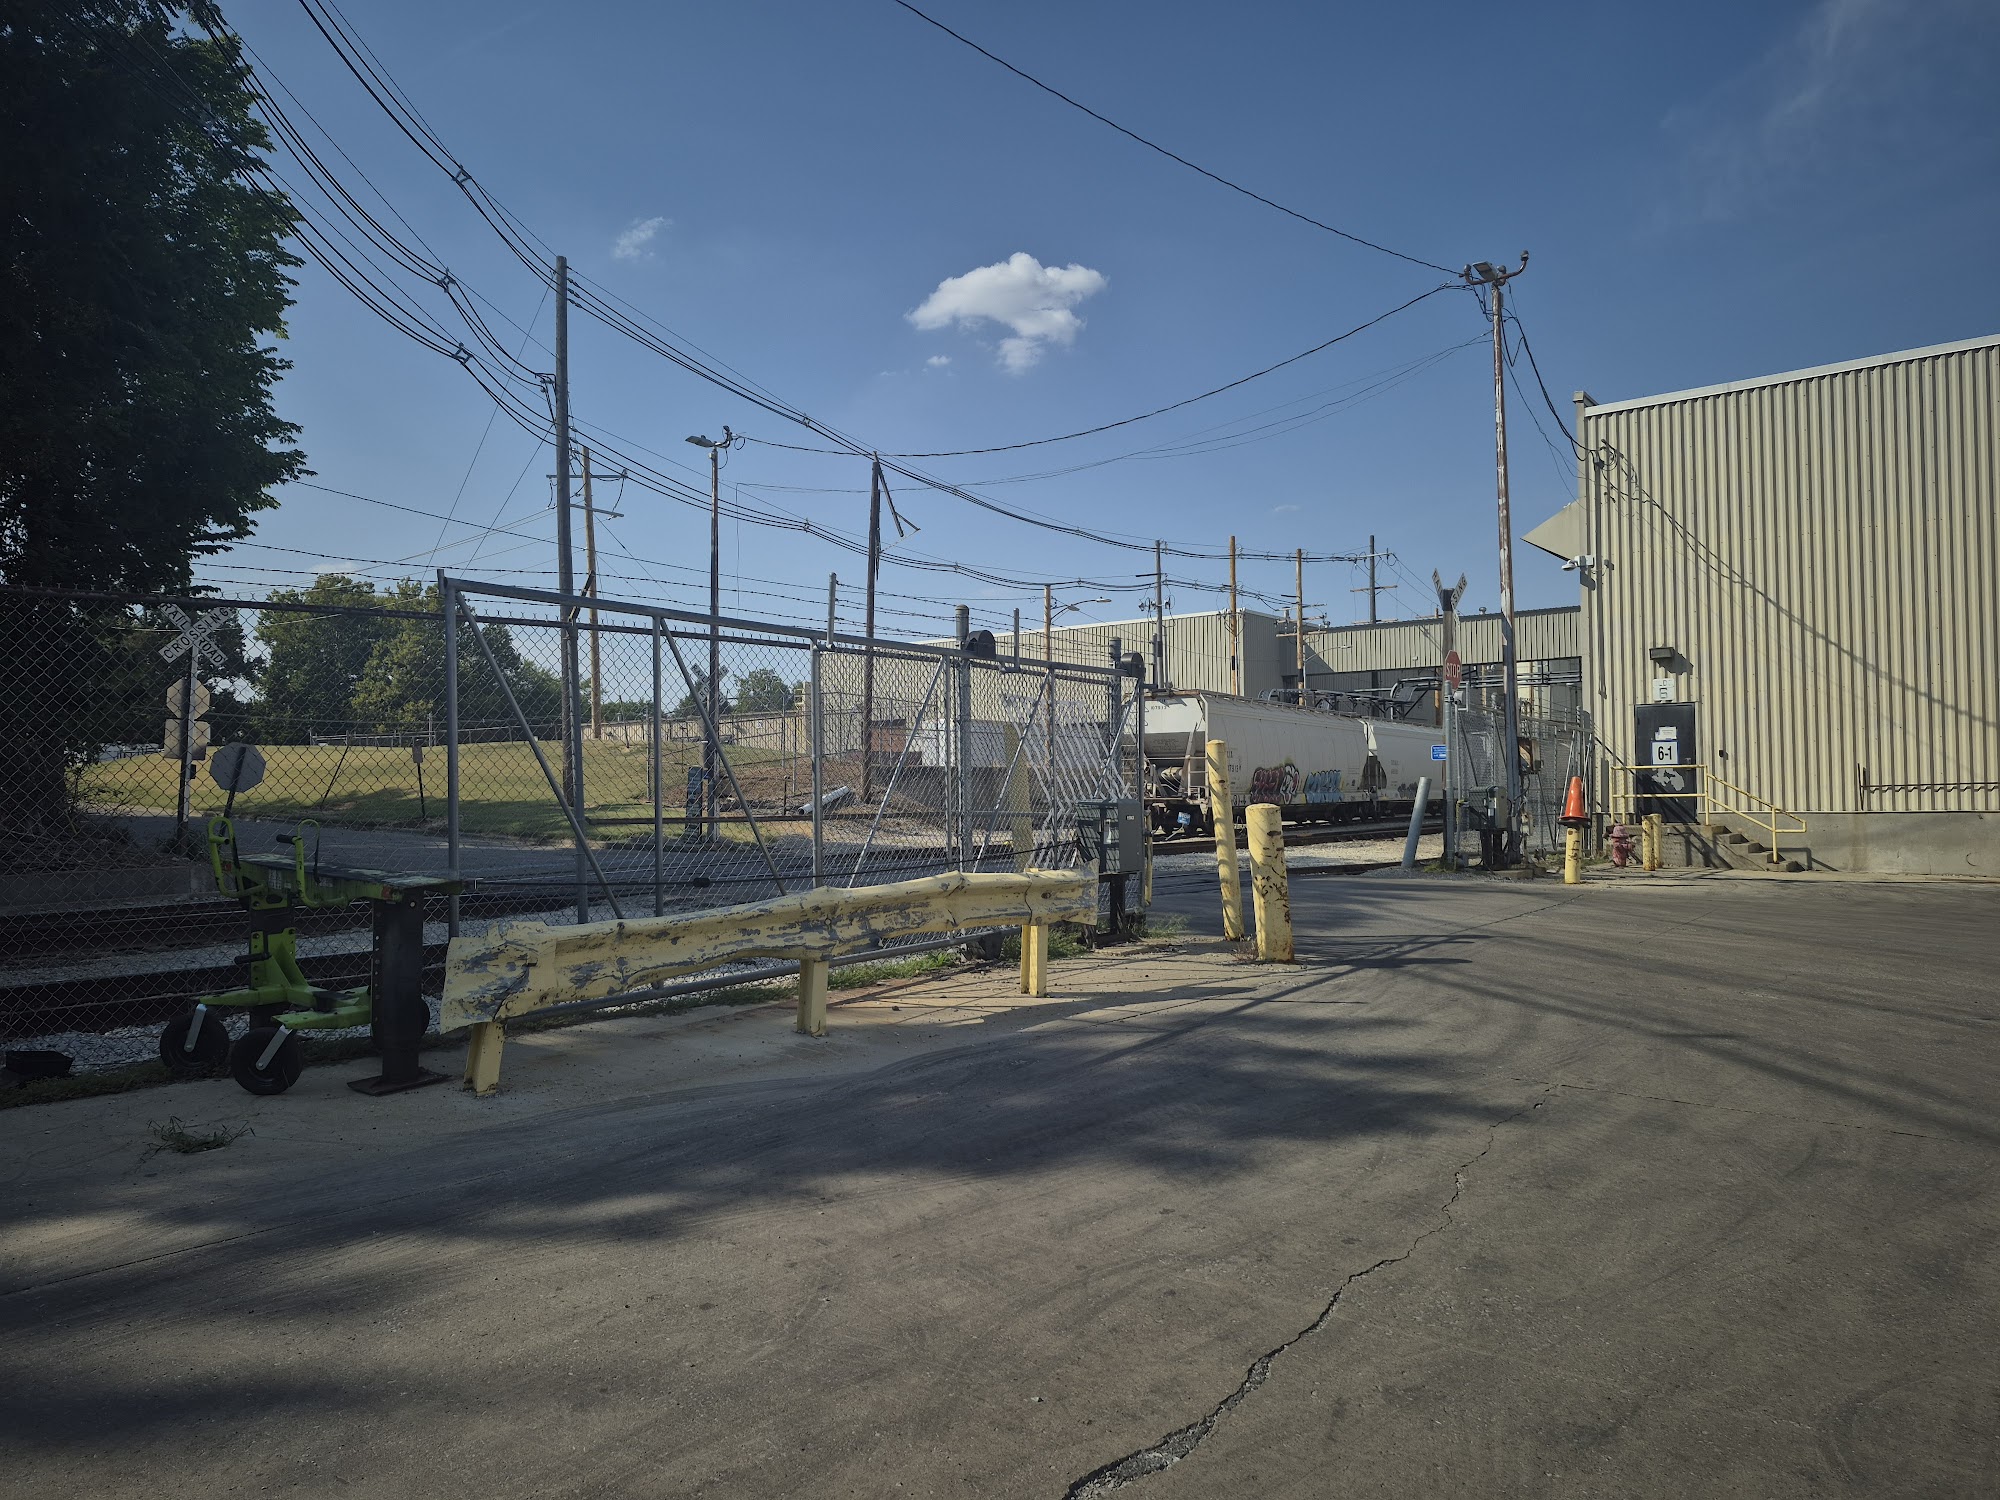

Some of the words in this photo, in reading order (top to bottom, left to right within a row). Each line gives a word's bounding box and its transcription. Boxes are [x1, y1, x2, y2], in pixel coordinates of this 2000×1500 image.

[163, 607, 229, 659] CROSSING
[1446, 662, 1461, 679] STOP
[1658, 745, 1672, 761] 6-1
